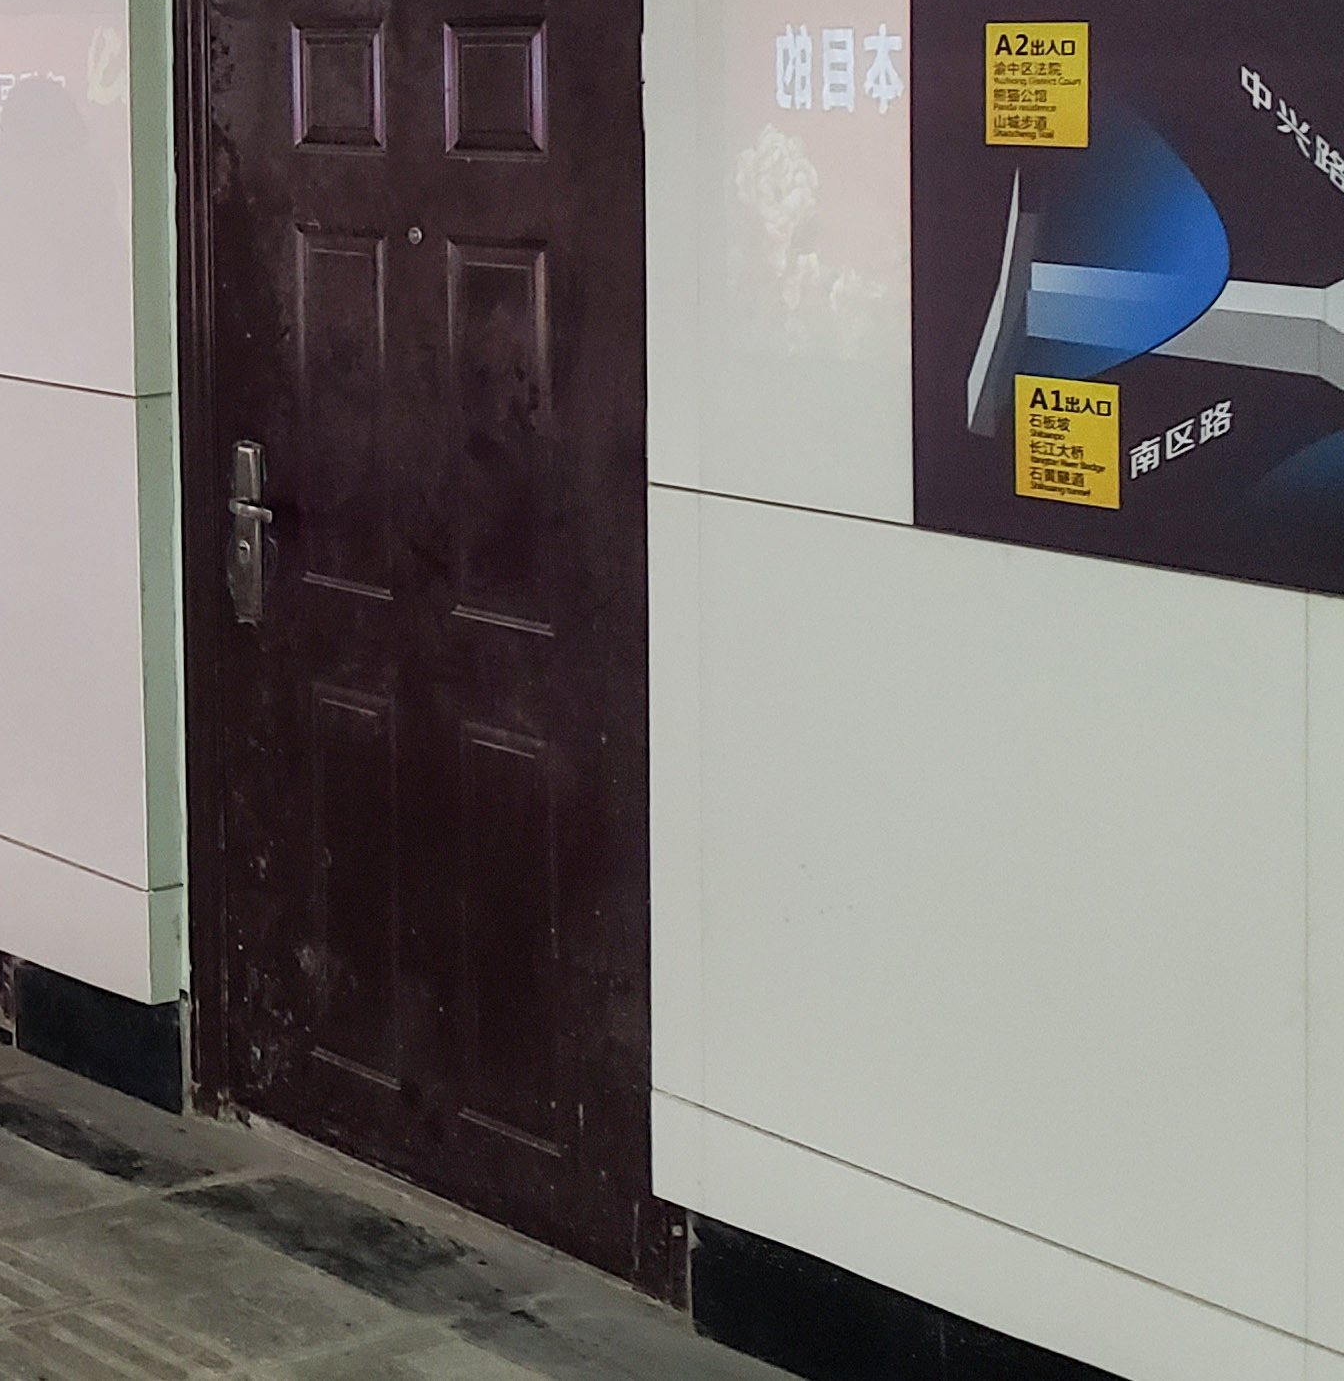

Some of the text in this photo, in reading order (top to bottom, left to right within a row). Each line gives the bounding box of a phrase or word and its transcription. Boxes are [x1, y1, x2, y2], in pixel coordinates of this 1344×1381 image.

[994, 33, 1076, 56] A2出入口
[1241, 65, 1344, 194] 中兴路
[1029, 387, 1112, 417] A1出入口
[1127, 399, 1234, 481] 南区路
